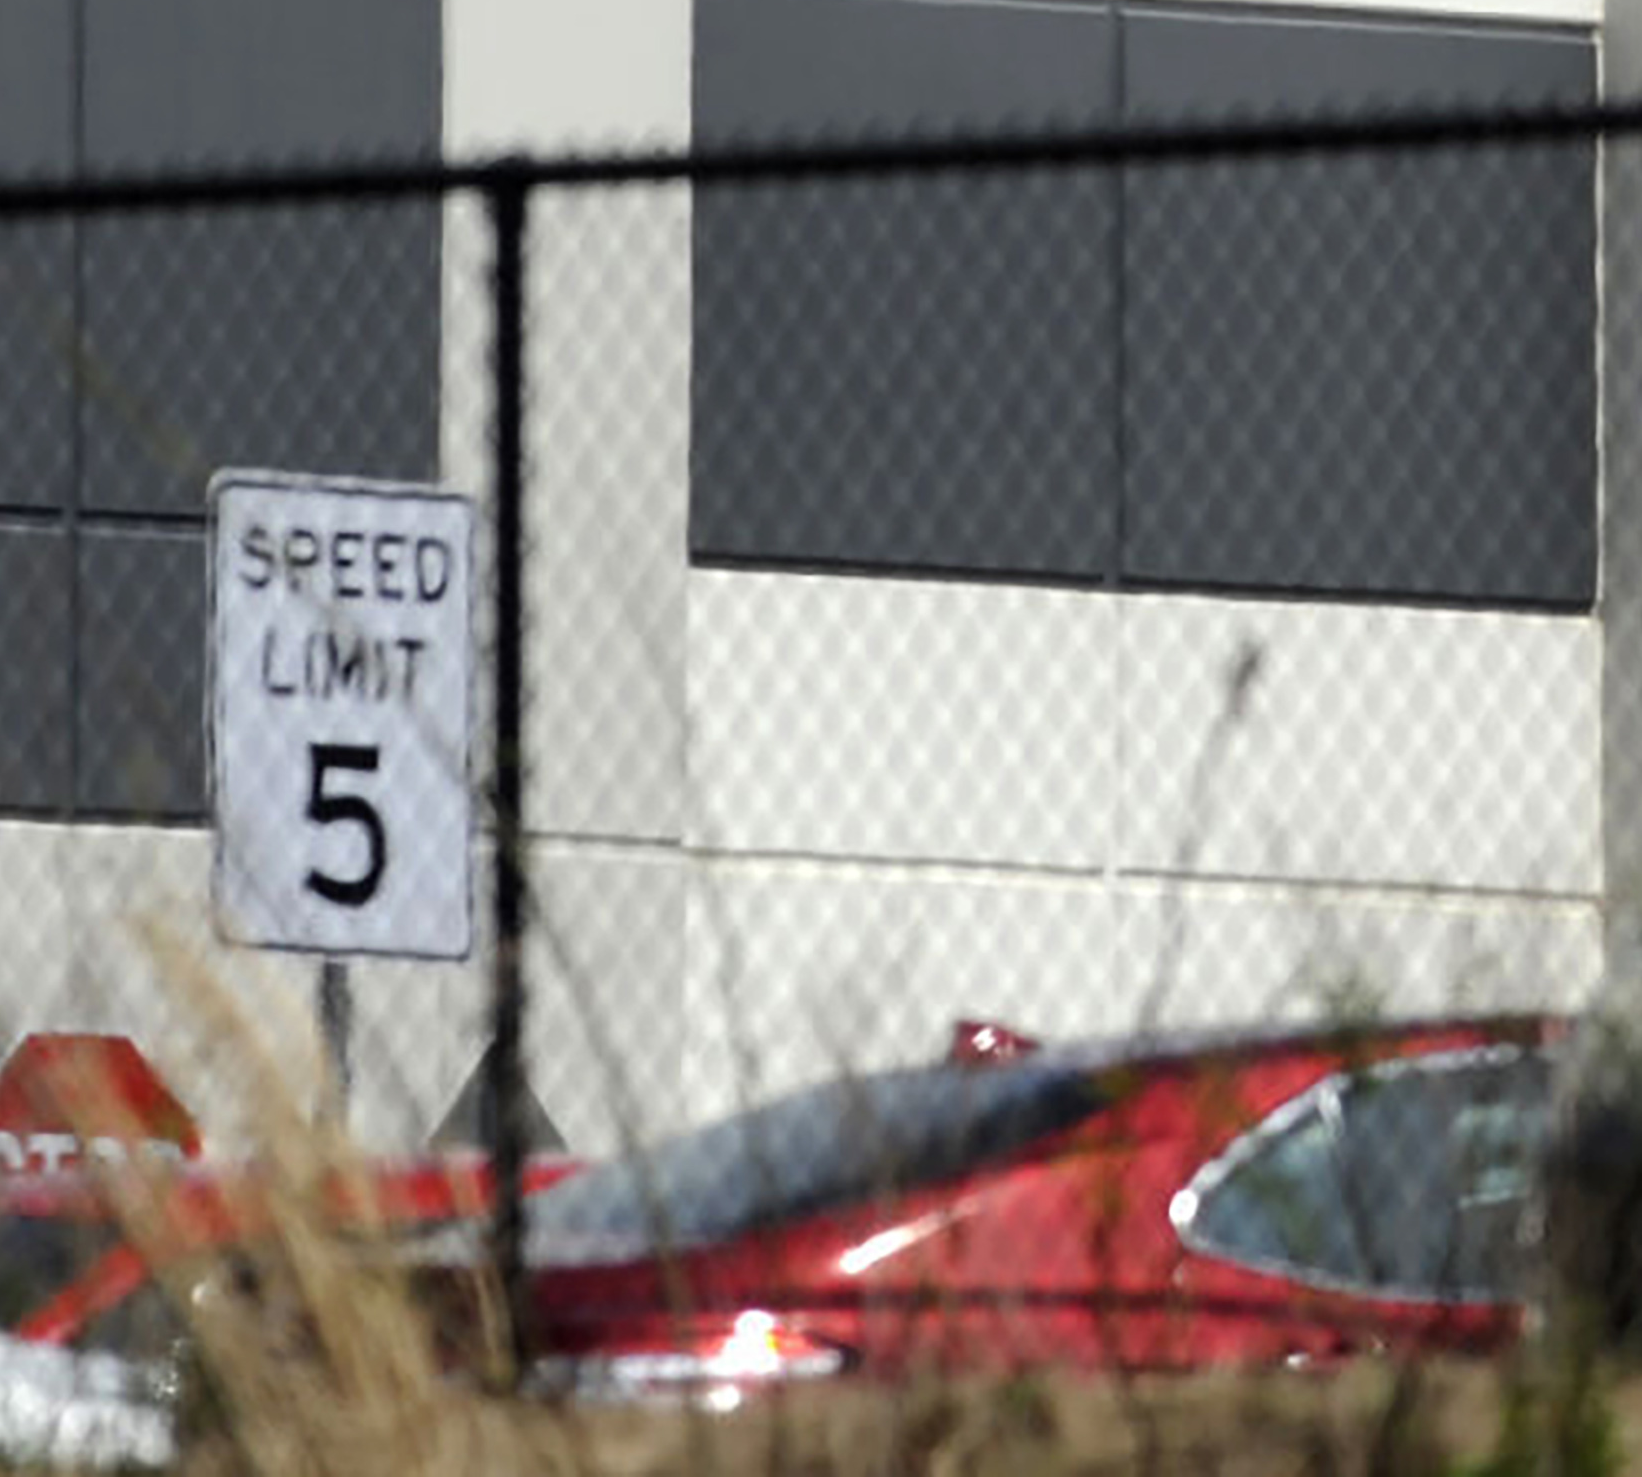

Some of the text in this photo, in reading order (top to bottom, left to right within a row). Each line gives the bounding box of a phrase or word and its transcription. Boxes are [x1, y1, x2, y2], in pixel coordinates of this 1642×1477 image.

[239, 527, 452, 605] SPEED
[262, 629, 426, 703] LIMIT
[303, 743, 388, 909] 5
